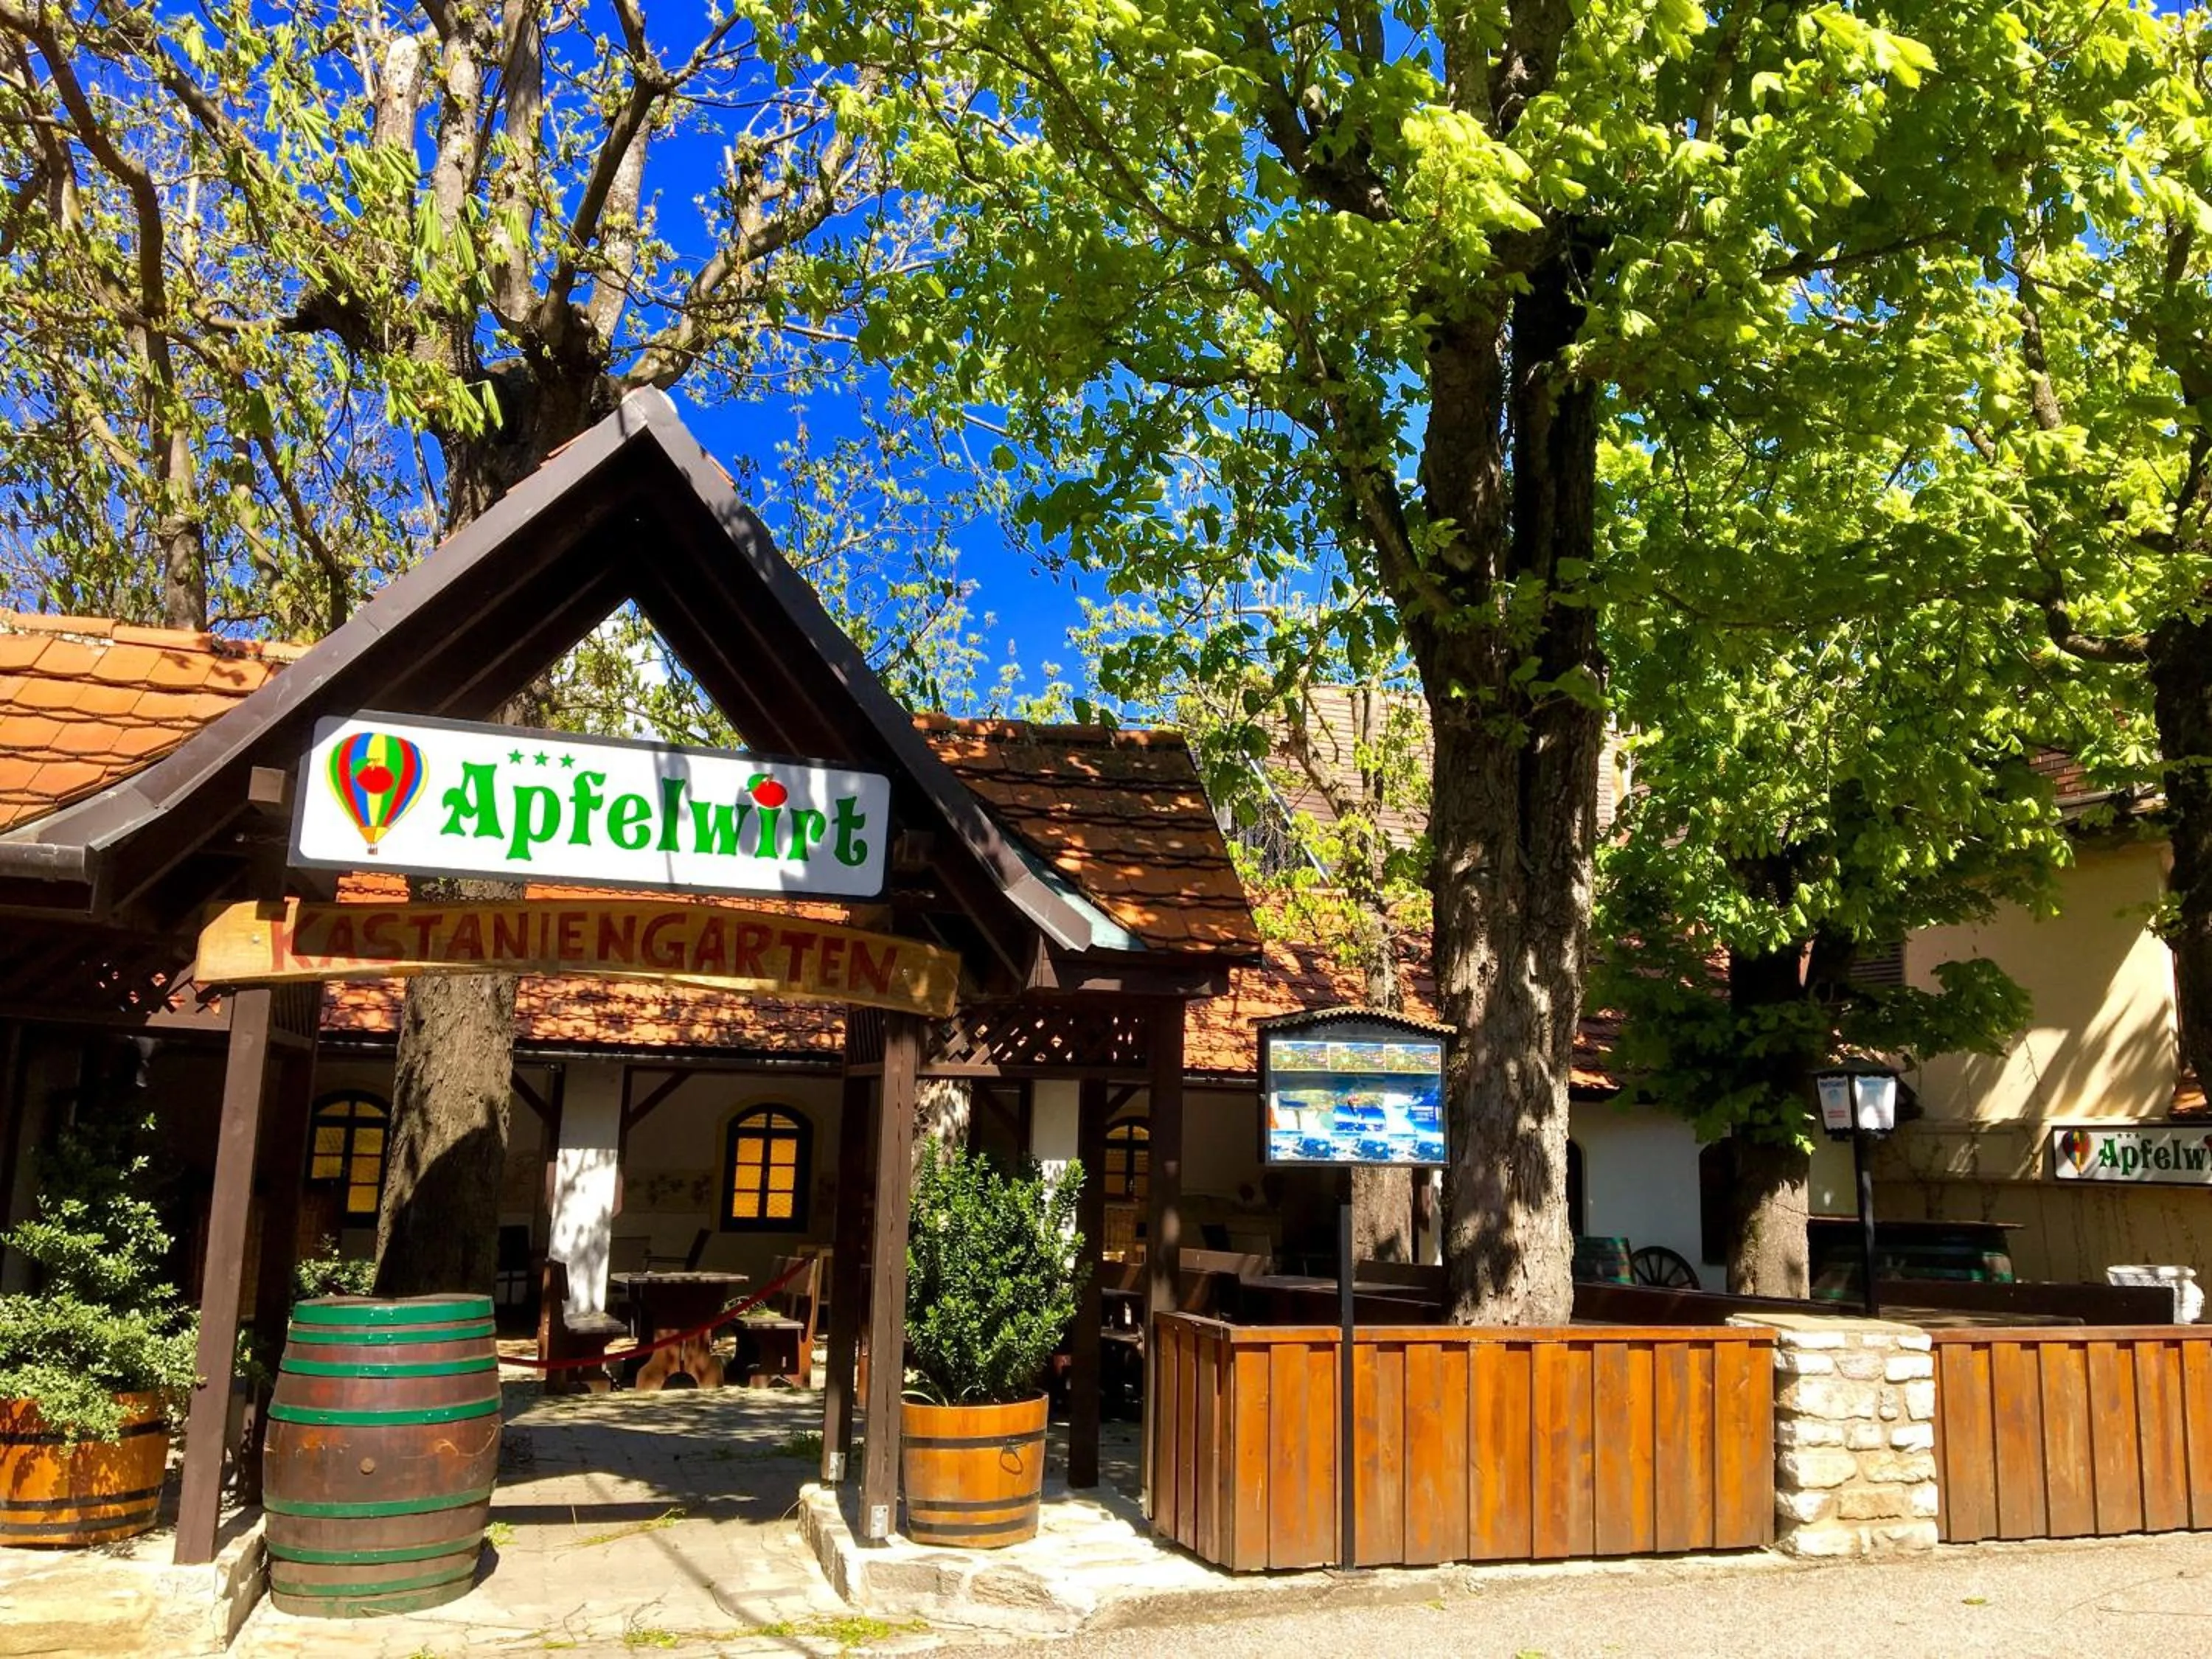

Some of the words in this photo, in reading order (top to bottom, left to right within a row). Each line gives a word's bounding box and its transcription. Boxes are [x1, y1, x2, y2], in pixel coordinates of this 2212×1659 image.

[440, 762, 869, 867] Apfelwirt
[270, 911, 897, 995] KASTANIENGARTEN
[2098, 1136, 2212, 1176] Apfelw
